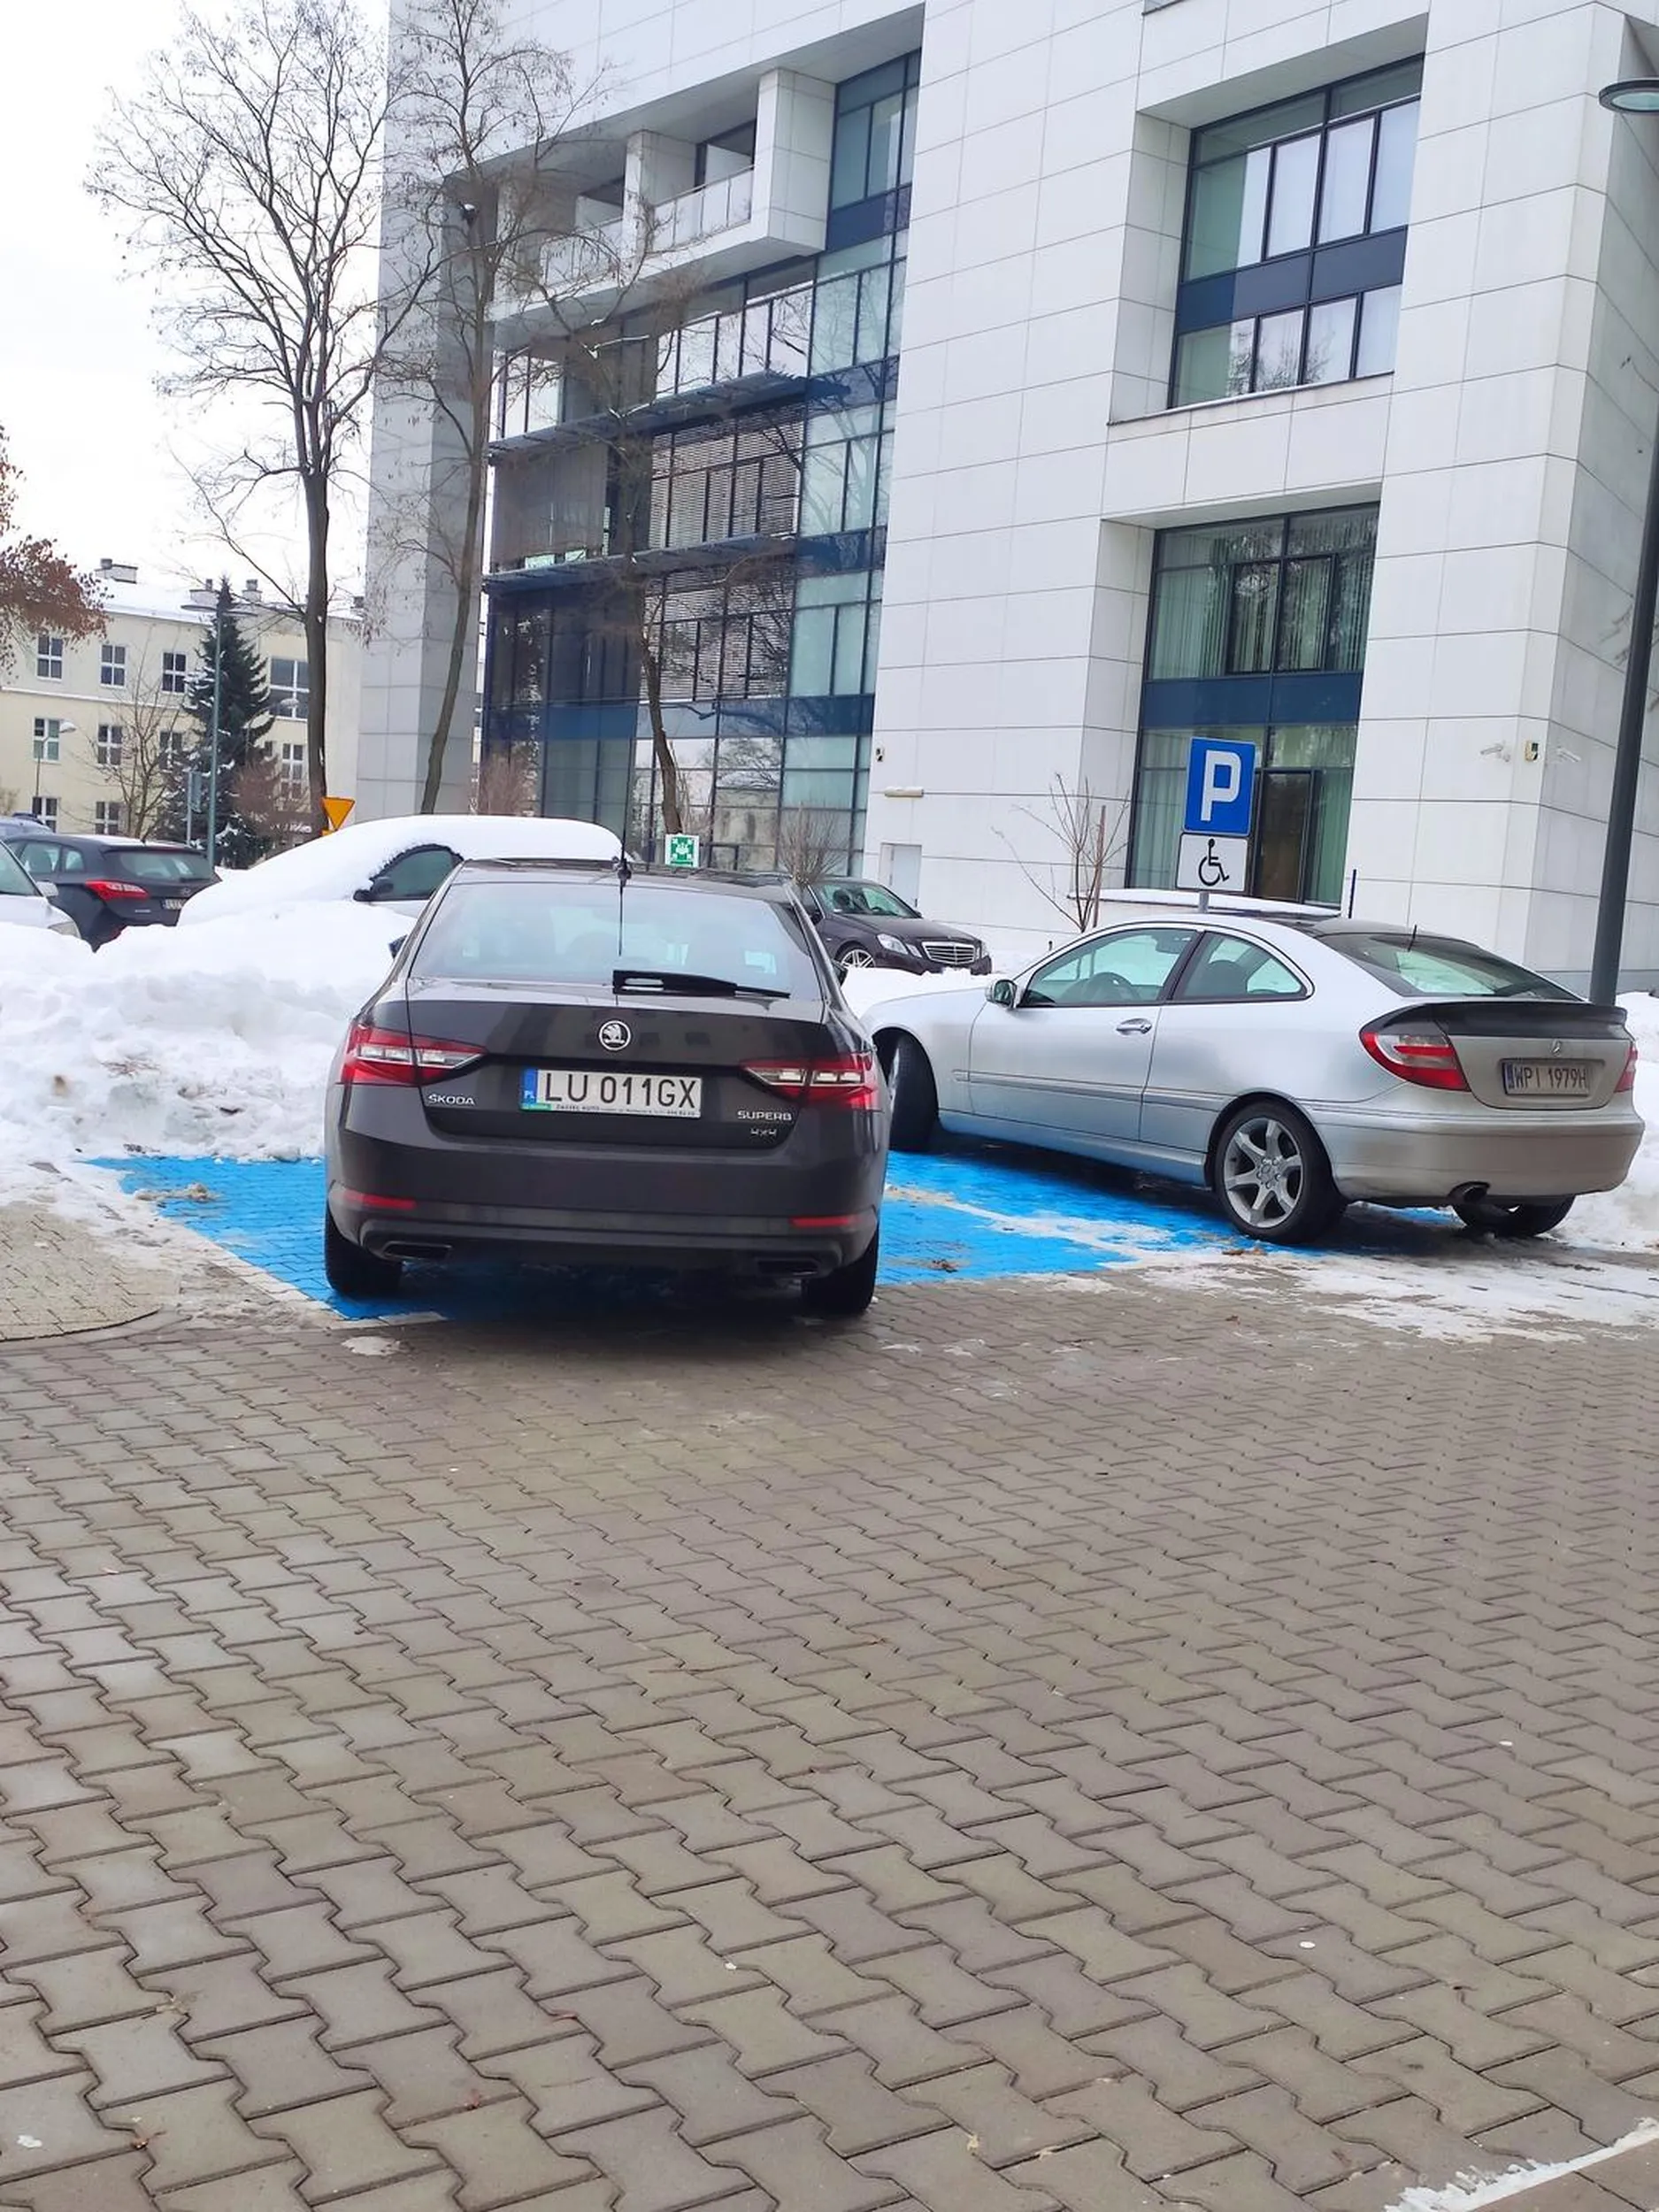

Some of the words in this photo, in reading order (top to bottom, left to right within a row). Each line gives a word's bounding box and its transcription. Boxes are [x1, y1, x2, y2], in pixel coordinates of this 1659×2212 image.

[1200, 749, 1242, 822] P
[545, 1073, 588, 1103] LU
[600, 1076, 695, 1109] 011GX
[737, 1110, 793, 1121] SUPERB
